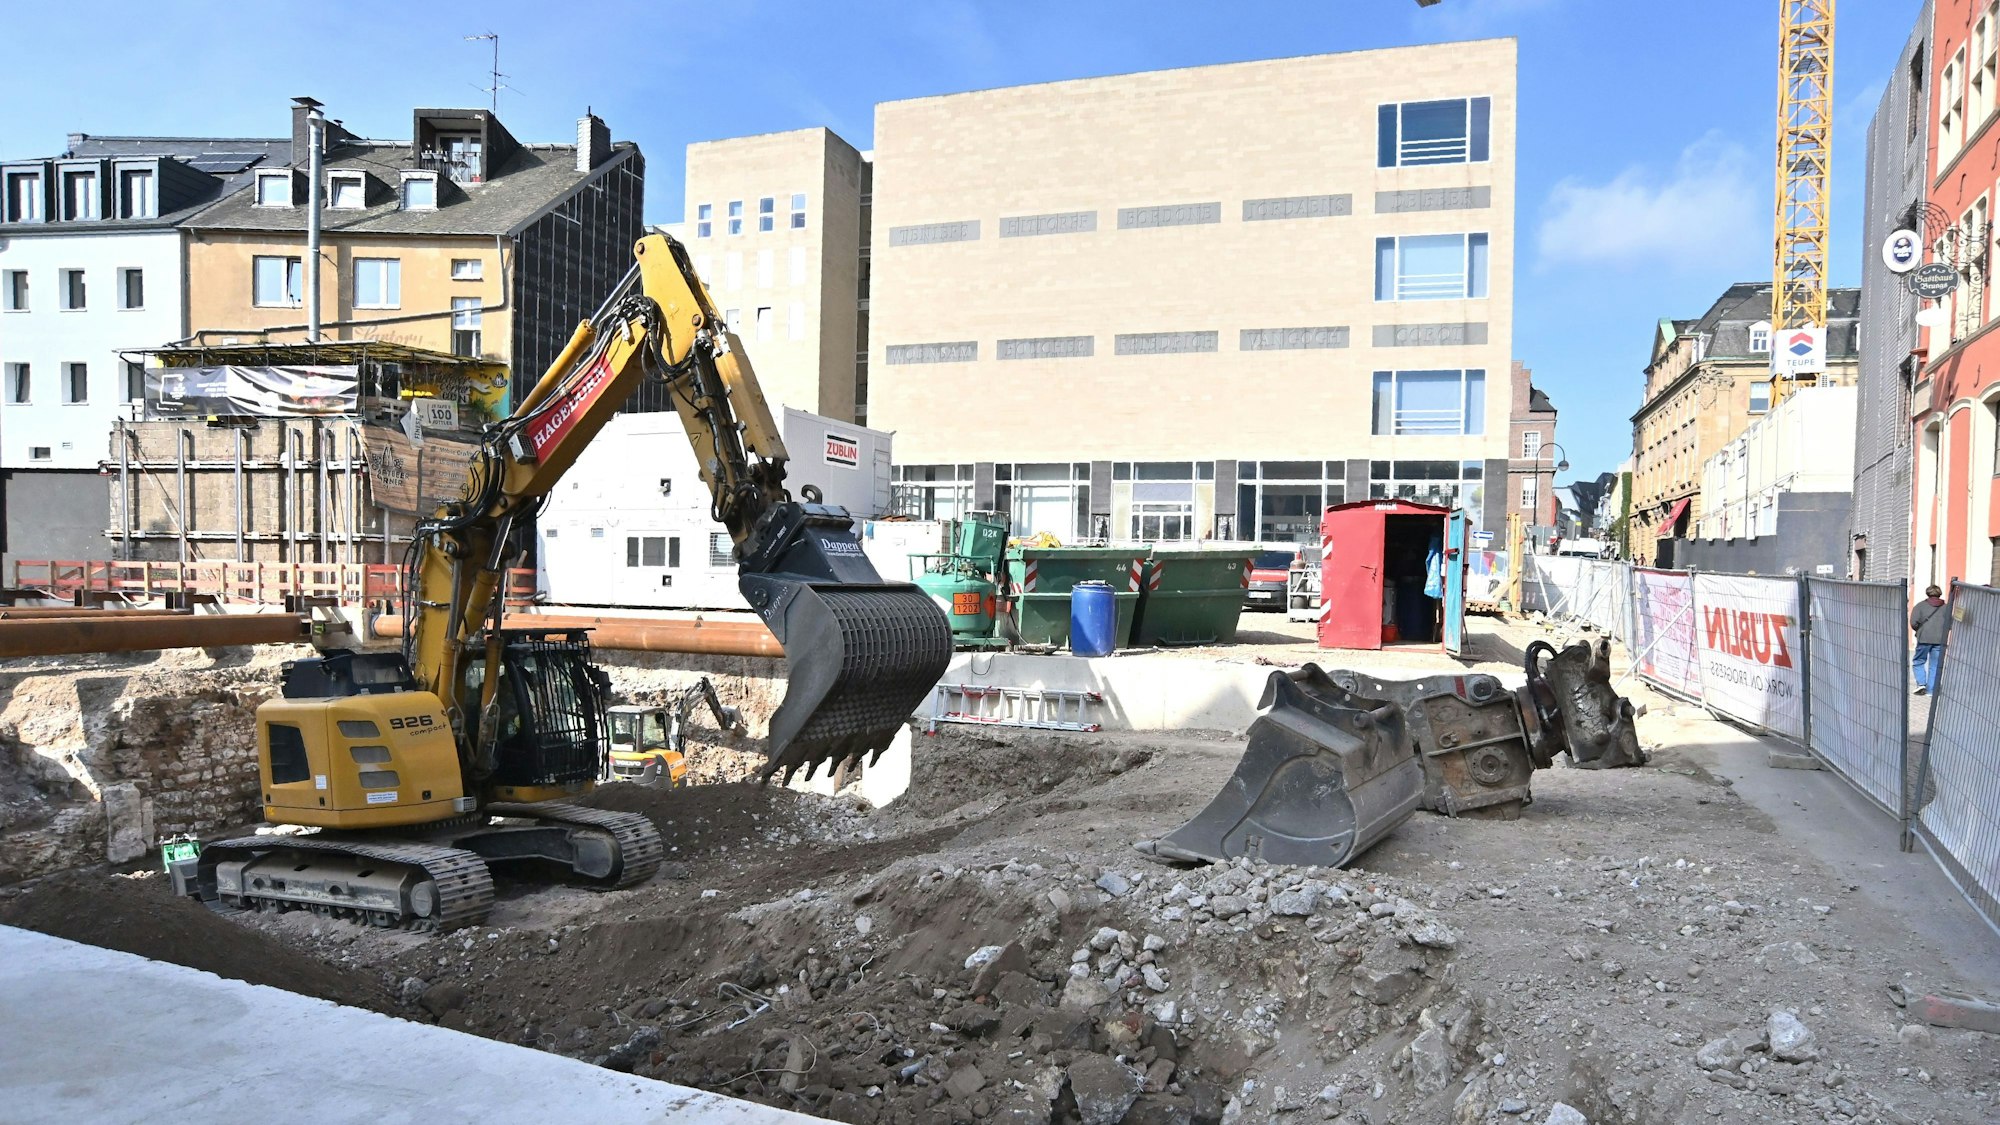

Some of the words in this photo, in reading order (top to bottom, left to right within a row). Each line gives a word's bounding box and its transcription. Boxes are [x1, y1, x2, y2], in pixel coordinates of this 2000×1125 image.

[1915, 274, 1953, 283] Gasthaus
[431, 408, 452, 420] 100
[827, 441, 857, 459] ZÜBLIN
[821, 539, 860, 552] Dappen
[1116, 564, 1127, 572] 44
[1227, 562, 1237, 570] 43
[962, 594, 973, 603] 30
[957, 603, 978, 614] 1202
[389, 714, 433, 730] 926
[409, 722, 447, 737] compact
